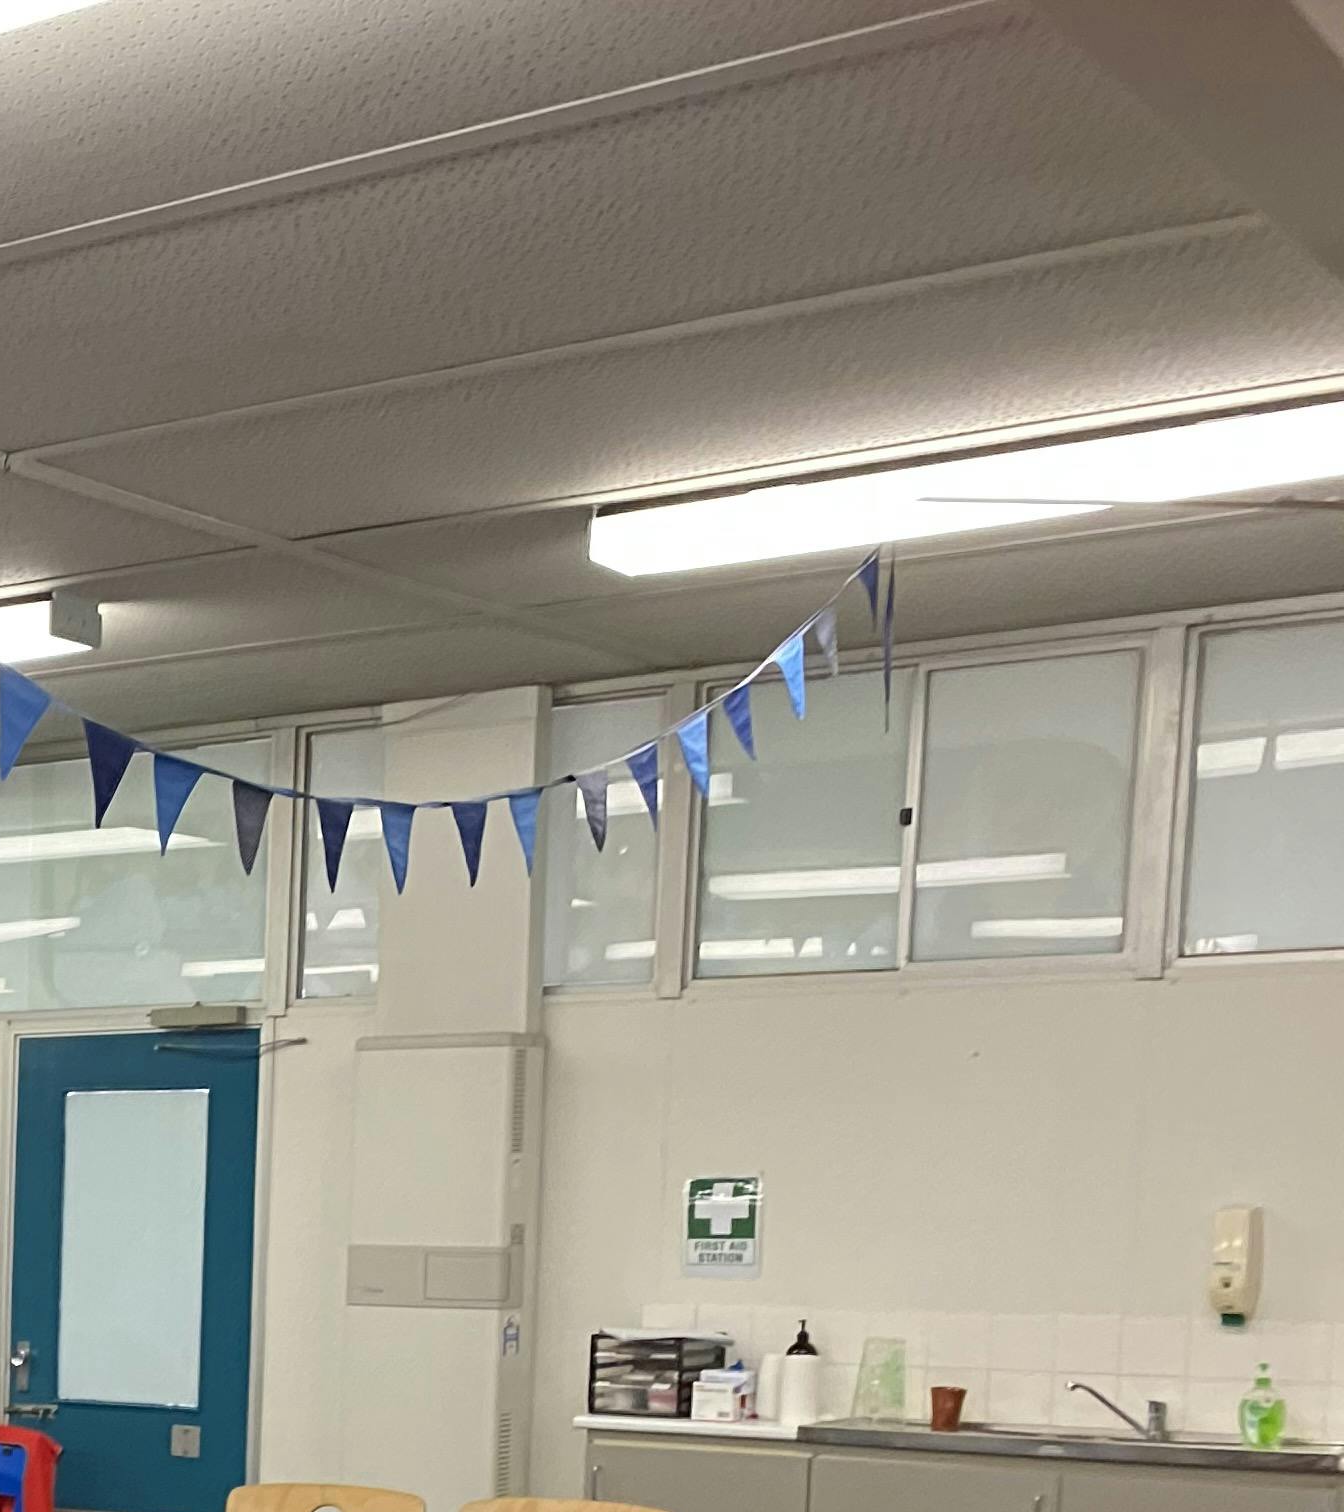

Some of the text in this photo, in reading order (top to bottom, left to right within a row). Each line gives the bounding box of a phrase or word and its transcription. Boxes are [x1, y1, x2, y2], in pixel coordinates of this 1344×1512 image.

[694, 1241, 747, 1251] FIRST AID
[698, 1253, 743, 1263] STATION
